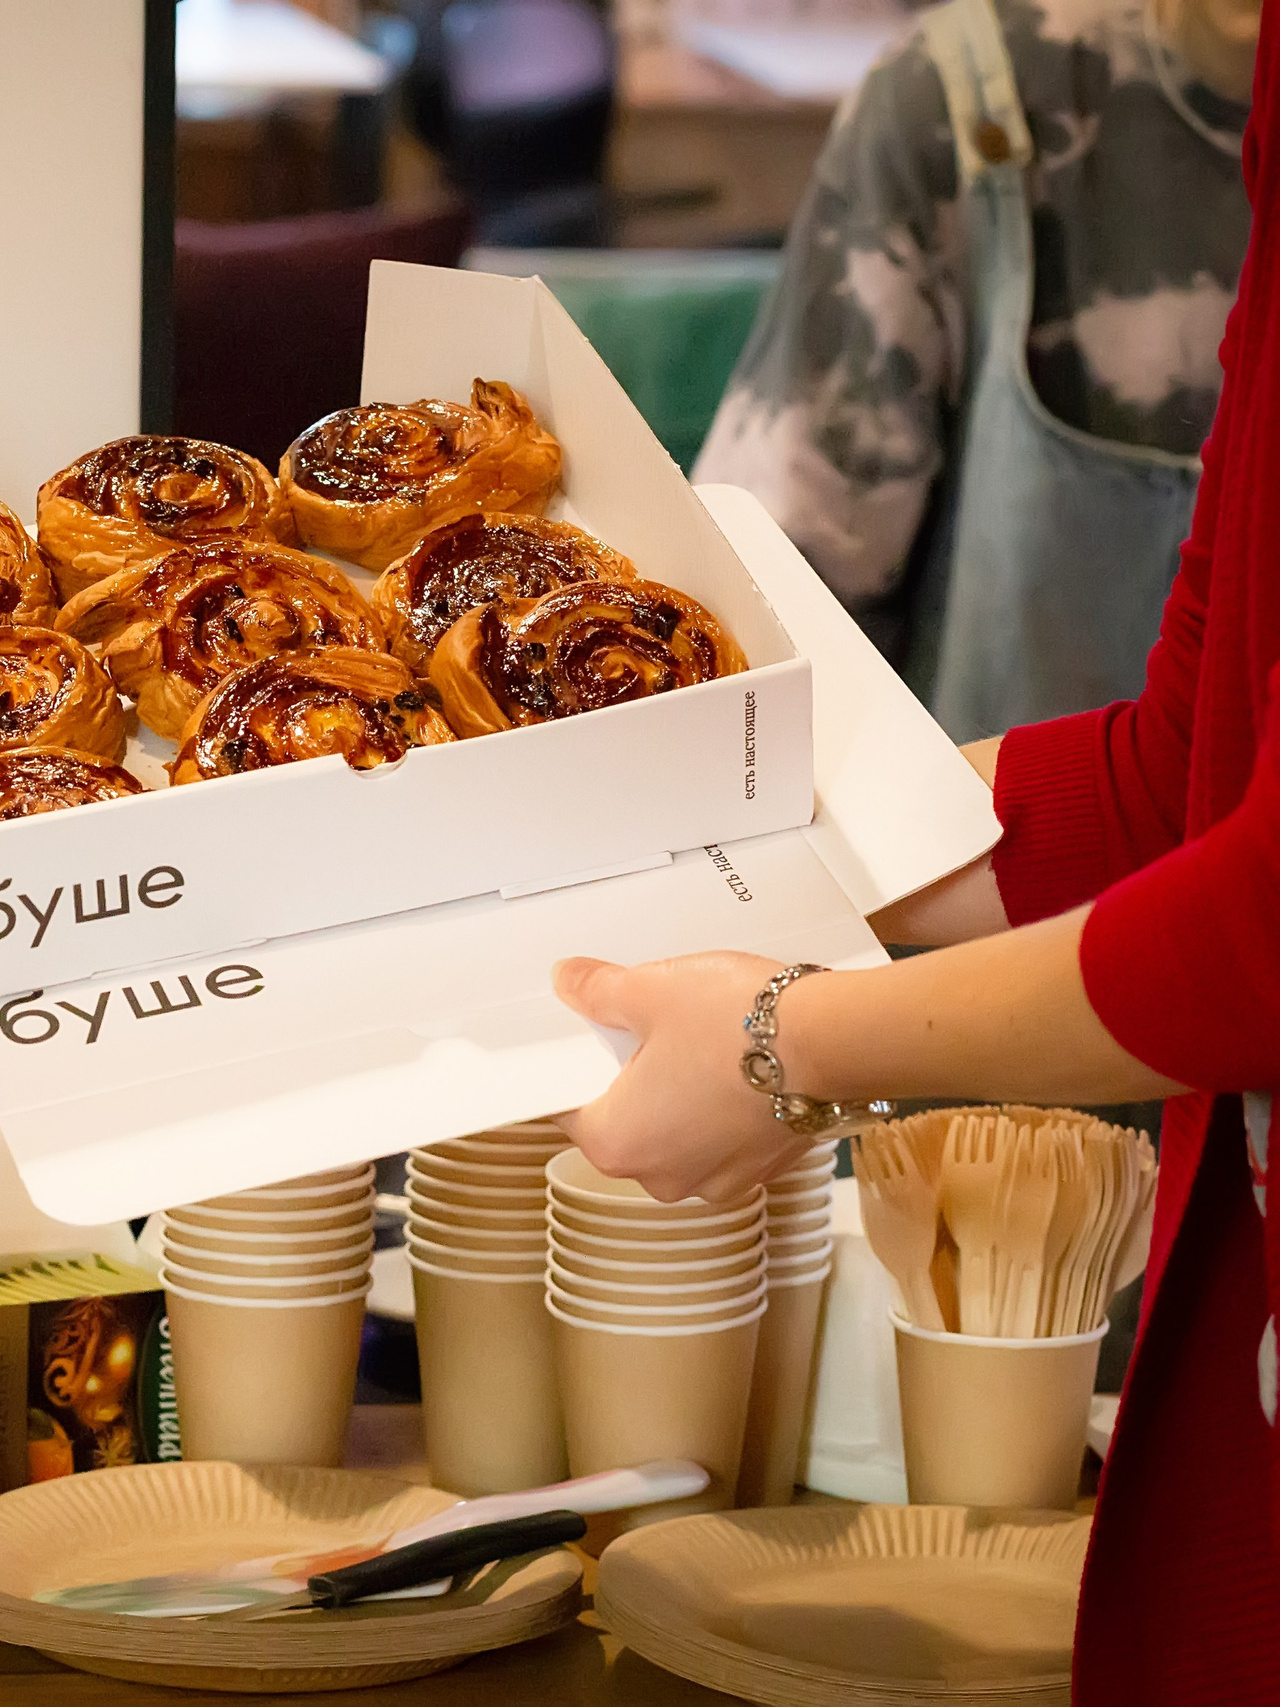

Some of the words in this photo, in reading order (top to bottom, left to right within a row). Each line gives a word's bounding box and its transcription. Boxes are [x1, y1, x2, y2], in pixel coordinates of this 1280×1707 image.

[745, 690, 758, 768] настоящее
[745, 769, 756, 800] есть
[725, 873, 753, 902] есть
